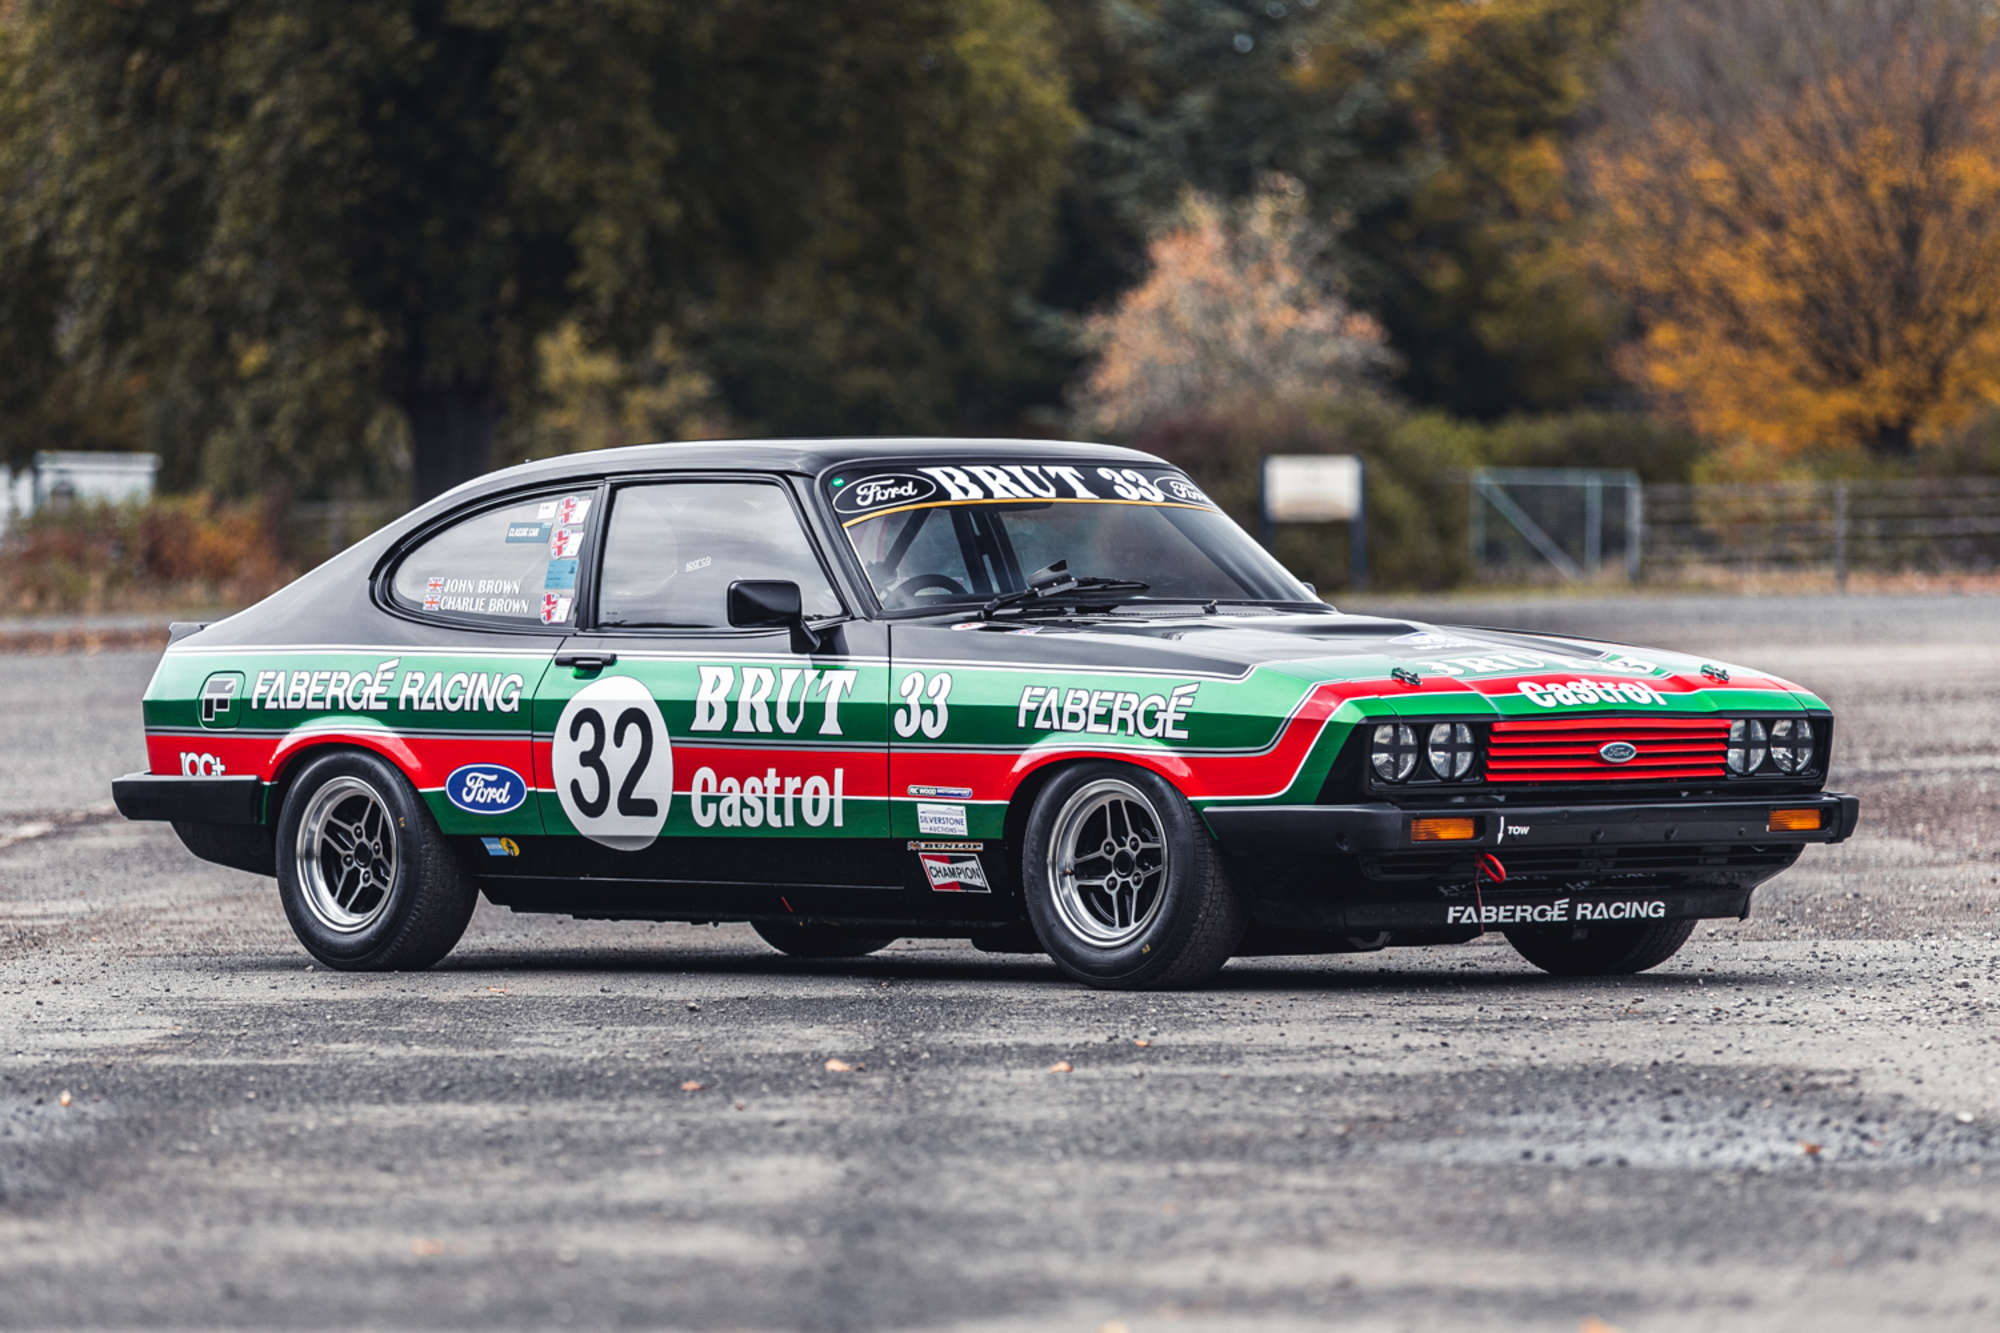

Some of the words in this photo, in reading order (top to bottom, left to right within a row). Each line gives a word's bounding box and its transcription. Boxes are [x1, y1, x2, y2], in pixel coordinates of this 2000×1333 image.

[856, 479, 918, 506] Ford
[917, 466, 1100, 500] BRUT
[1096, 467, 1165, 502] 33
[444, 579, 476, 593] JOHN
[478, 580, 521, 594] BROWN
[440, 596, 487, 611] CHARLIE
[488, 598, 530, 613] BROWN
[250, 657, 401, 711] FABERGÉ
[398, 671, 525, 712] RACING
[690, 665, 858, 735] BRUT
[1517, 678, 1667, 708] Castrol
[894, 671, 952, 739] 33
[1017, 681, 1201, 740] FABERGÉ
[568, 706, 658, 818] 32
[462, 772, 511, 804] Ford
[691, 766, 844, 828] Castrol
[920, 815, 965, 826] SILVERSTONE
[1507, 826, 1531, 836] TOW
[929, 865, 983, 881] CHAMPION
[1447, 898, 1571, 924] FABERGÉ
[1575, 901, 1666, 921] RACING
